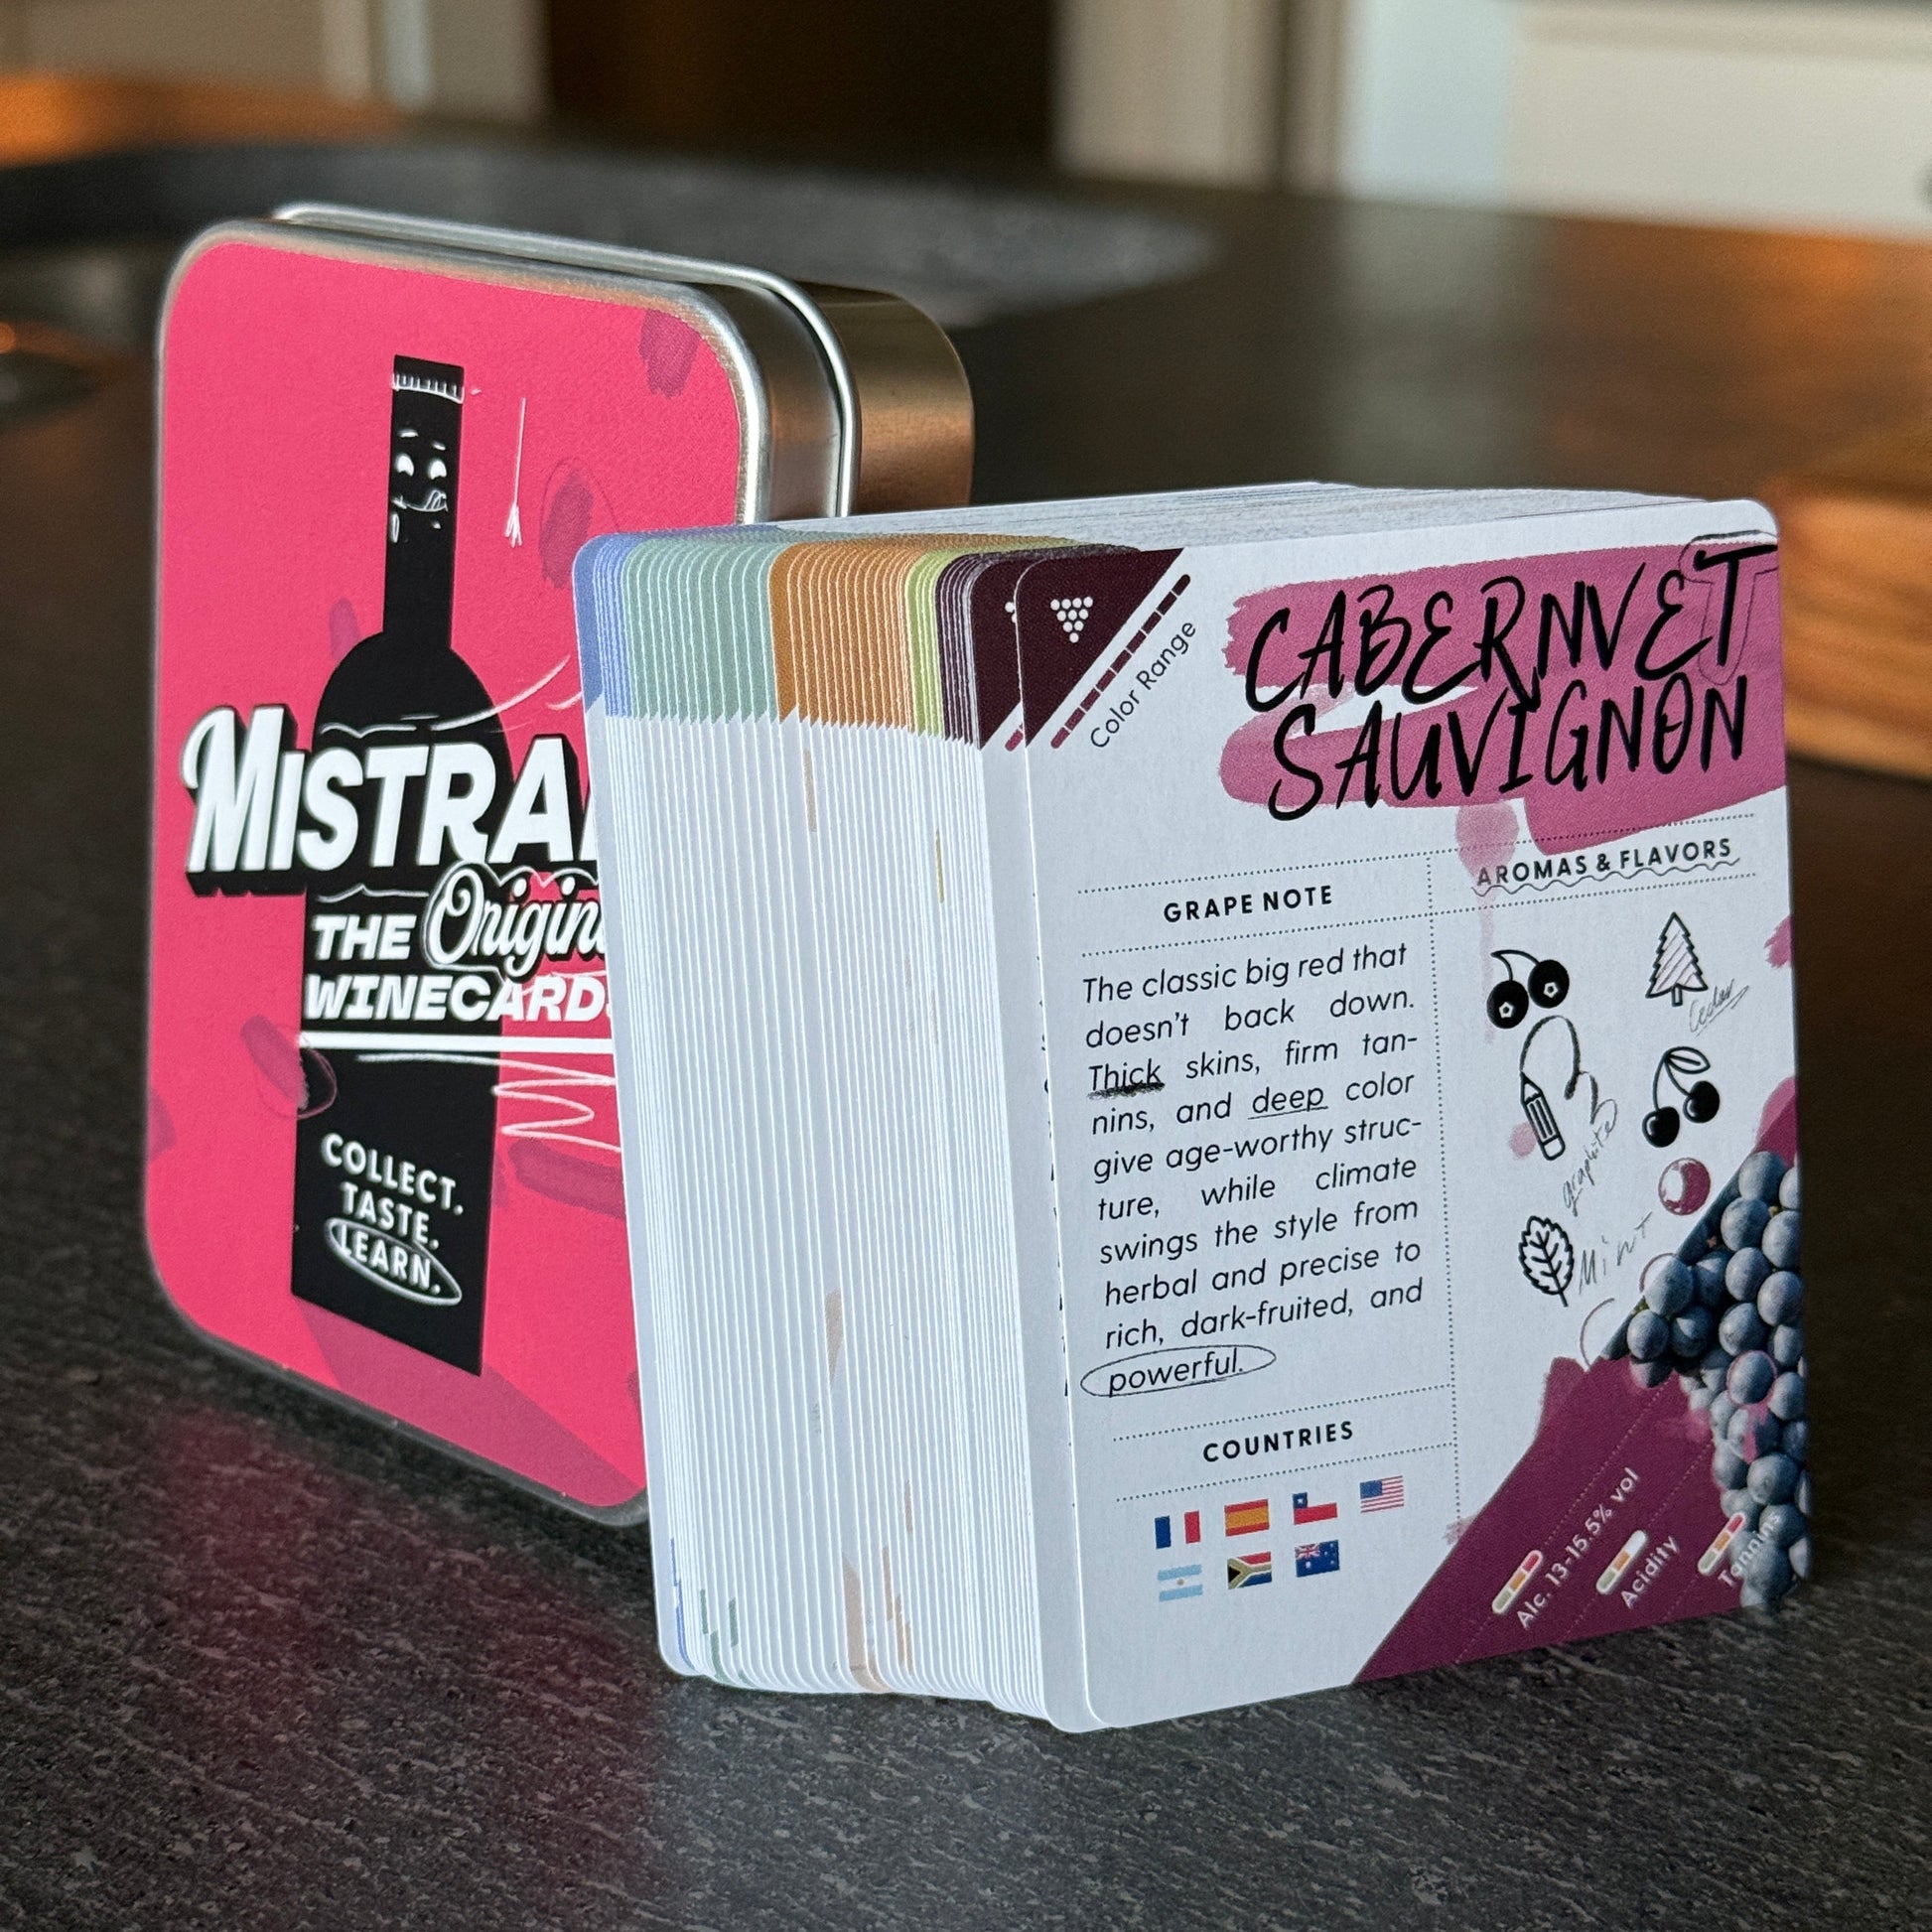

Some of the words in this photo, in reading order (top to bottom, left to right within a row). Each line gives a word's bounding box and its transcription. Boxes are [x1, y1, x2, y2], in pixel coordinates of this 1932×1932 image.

[1090, 689, 1141, 748] Color
[1135, 621, 1196, 691] Range
[1268, 675, 1748, 821] SAUVIGNON
[1477, 856, 1587, 886] AROMAS
[1595, 853, 1611, 872] &
[1619, 838, 1731, 870] FLAVORS
[1164, 894, 1253, 922] GRAPE
[1263, 885, 1332, 911] NOTE
[312, 913, 417, 961] THE
[304, 974, 613, 1023] WINECARD
[1083, 976, 1133, 1003] The
[1142, 963, 1237, 998] classic
[1246, 958, 1290, 987] big
[1298, 948, 1343, 978] red
[1352, 942, 1407, 971] that
[1086, 1012, 1189, 1047] doesn't
[1224, 998, 1296, 1031] back
[1329, 990, 1415, 1018] down.
[1089, 1057, 1163, 1091] Thick
[1185, 1050, 1261, 1079] skins,
[1286, 1039, 1338, 1066] firm
[1362, 1032, 1418, 1056] tan-
[1092, 1107, 1155, 1135] nins,
[1175, 1092, 1232, 1124] and
[1252, 1085, 1324, 1114] deep
[1345, 1070, 1415, 1101] color
[320, 1132, 464, 1216] COLLECT.
[1093, 1151, 1154, 1183] give
[1166, 1125, 1333, 1172] age-worthy
[1343, 1115, 1422, 1144] struc-
[340, 1181, 440, 1250] TASTE.
[1098, 1195, 1160, 1221] ture,
[1200, 1173, 1276, 1206] while
[1315, 1157, 1417, 1191] climate
[338, 1223, 441, 1295] LEARN.
[1099, 1228, 1198, 1264] swings
[1214, 1220, 1258, 1248] the
[1274, 1207, 1338, 1240] style
[1353, 1198, 1418, 1227] from
[1105, 1268, 1197, 1307] herbal
[1211, 1258, 1267, 1291] and
[1279, 1246, 1379, 1287] precise
[1395, 1239, 1422, 1263] to
[1105, 1318, 1164, 1349] rich,
[1180, 1288, 1353, 1337] dark-fruited,
[1369, 1277, 1424, 1309] and
[1109, 1347, 1244, 1397] powerful.
[1202, 1420, 1354, 1462] COUNTRIES
[1517, 1592, 1552, 1629] Alc.
[1545, 1504, 1613, 1587] 13-15.5%
[1609, 1466, 1641, 1503] vol
[1620, 1535, 1680, 1609] Acidity
[1717, 1510, 1782, 1587] Tannins
